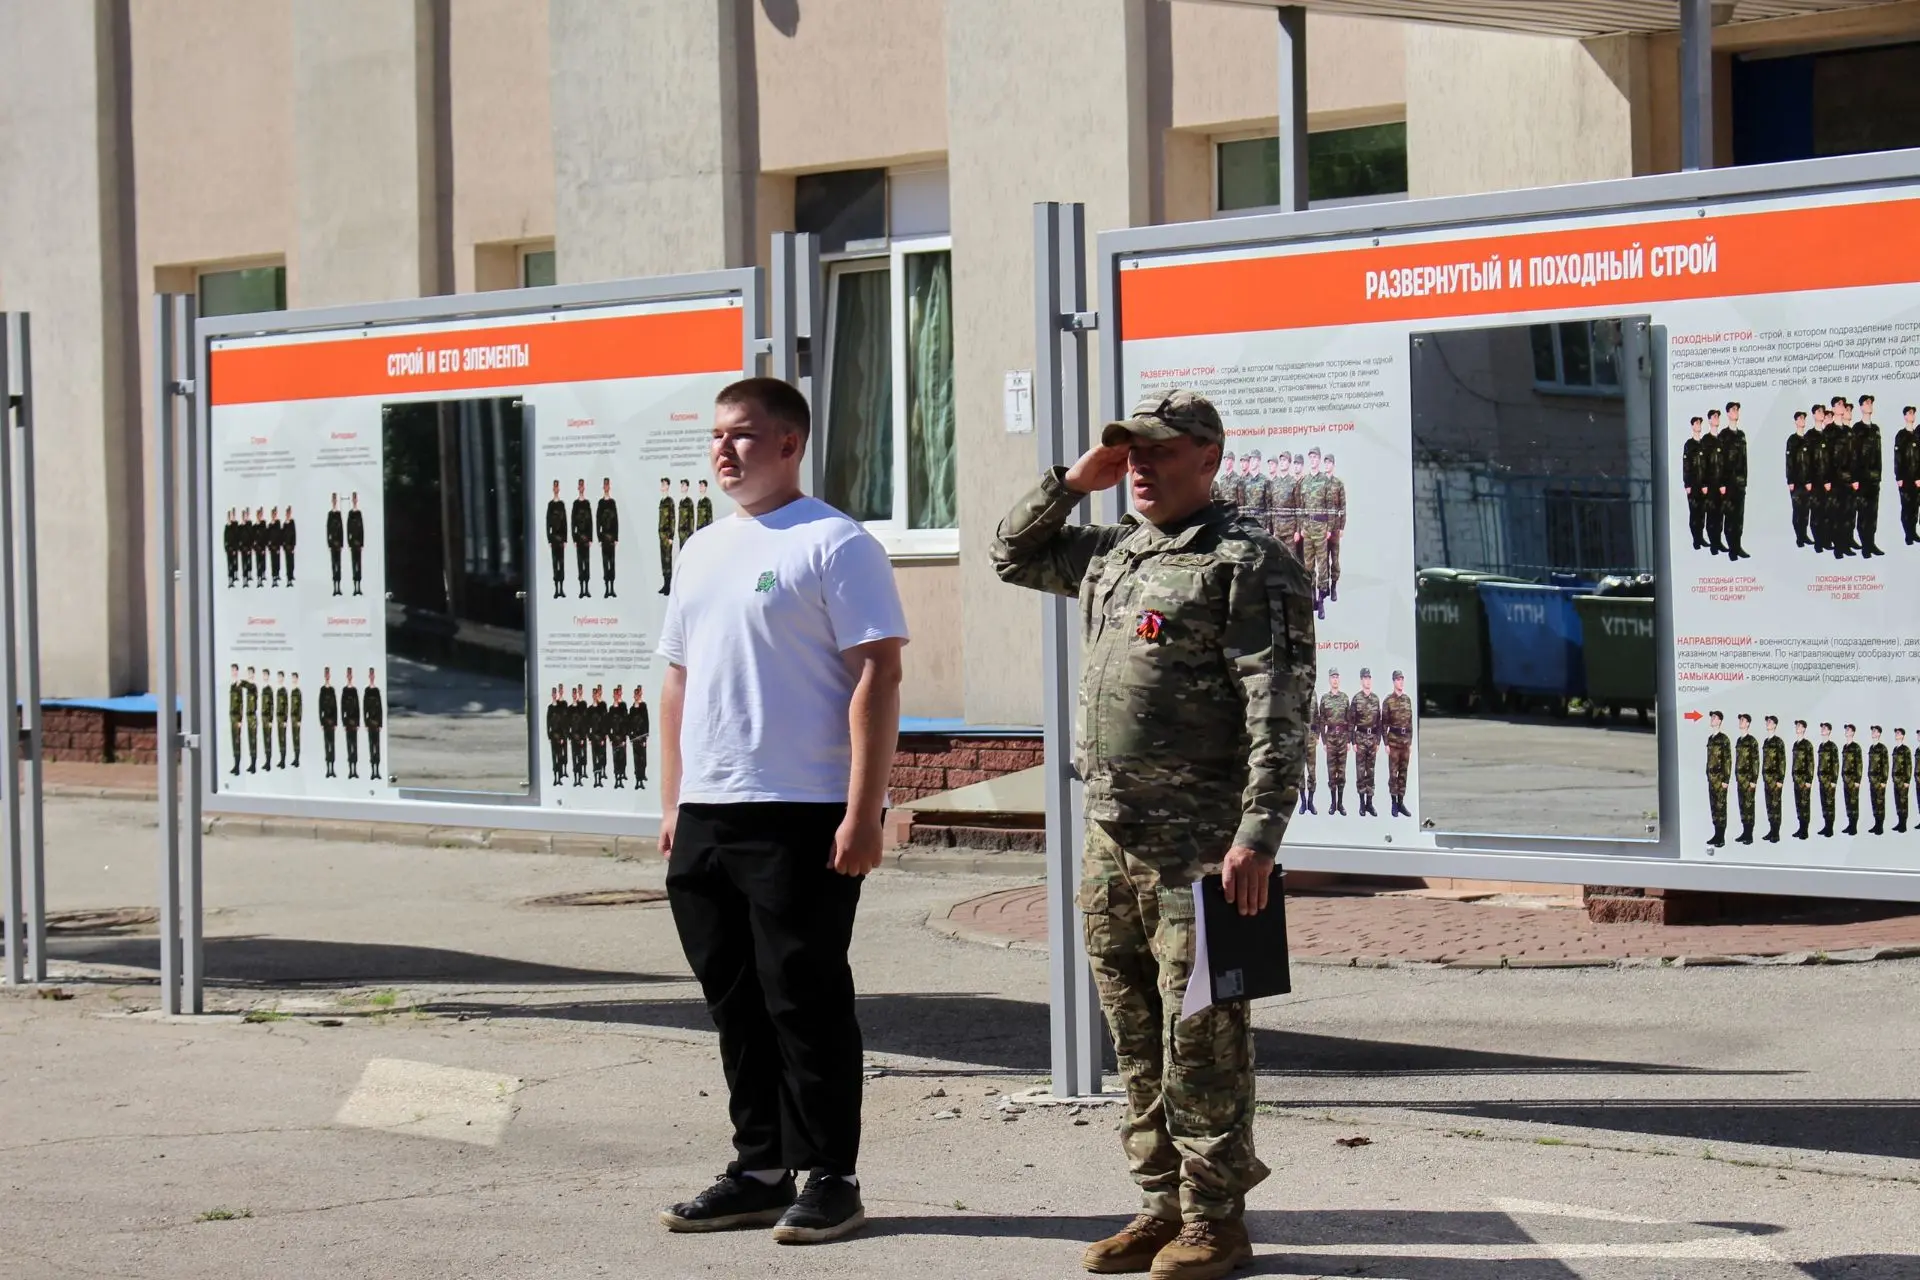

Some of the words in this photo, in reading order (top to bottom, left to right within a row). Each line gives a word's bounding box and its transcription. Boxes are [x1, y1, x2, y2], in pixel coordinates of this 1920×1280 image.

[1365, 254, 1502, 300] РАЗВЕРНУТЫЙ
[1509, 259, 1522, 288] И
[1529, 241, 1643, 287] ПОХОДНЫЙ
[1651, 235, 1717, 277] СТРОЙ
[1672, 333, 1721, 344] ПОХОДНЫЙ
[1723, 330, 1752, 340] СТРОЙ
[1794, 328, 1827, 338] котором
[1829, 324, 1893, 335] подразделение
[1672, 346, 1731, 358] подразделения
[1740, 344, 1775, 353] колоннах
[1778, 341, 1821, 352] построены
[1823, 340, 1844, 348] одно
[1856, 337, 1886, 348] другим
[387, 347, 424, 376] СТРОЙ
[427, 351, 436, 374] И
[439, 349, 460, 373] ЕГО
[463, 343, 529, 371] ЭЛЕМЕНТЫ
[1672, 358, 1730, 370] установленных
[1733, 354, 1765, 365] Уставом
[1767, 355, 1782, 363] или
[1838, 348, 1880, 359] Походный
[1883, 346, 1907, 357] строй
[1140, 368, 1190, 379] РАЗВЕРНУТЫЙ
[1192, 366, 1216, 376] СТРОЙ
[1247, 364, 1274, 373] котором
[1672, 371, 1728, 382] передвижения
[1730, 365, 1790, 377] подразделений
[1793, 366, 1807, 375] при
[1809, 362, 1859, 373] совершении
[1170, 379, 1193, 389] фронту
[1327, 369, 1348, 379] строю
[1672, 382, 1733, 393] торжественным
[1819, 375, 1843, 384] также
[1852, 373, 1879, 384] других
[1268, 423, 1325, 437] развернутый
[1328, 421, 1355, 433] строй
[1699, 576, 1734, 584] ПОХОДНЫЙ
[1735, 575, 1756, 583] СТРОЙ
[1854, 574, 1876, 582] СТРОЙ
[1691, 585, 1728, 593] ОТДЕЛЕНИЯ
[1807, 584, 1846, 592] ОТДЕЛЕНИЯ
[1854, 583, 1884, 591] КОЛОННУ
[1720, 594, 1746, 602] ОДНОМУ
[1333, 640, 1360, 652] строй
[1677, 636, 1752, 646] НАПРАВЛЯЮЩИЙ
[1759, 637, 1828, 647] военнослужащий
[1904, 638, 1920, 646] дви
[1677, 650, 1718, 660] указанном
[1775, 648, 1786, 658] По
[1788, 650, 1856, 660] направляющему
[1857, 648, 1906, 660] сообразуют
[1677, 661, 1719, 670] остальные
[1721, 661, 1789, 671] военнослужащие
[1678, 670, 1744, 681] ЗАМЫКАЮЩИЙ
[1751, 673, 1820, 683] военнослужащий
